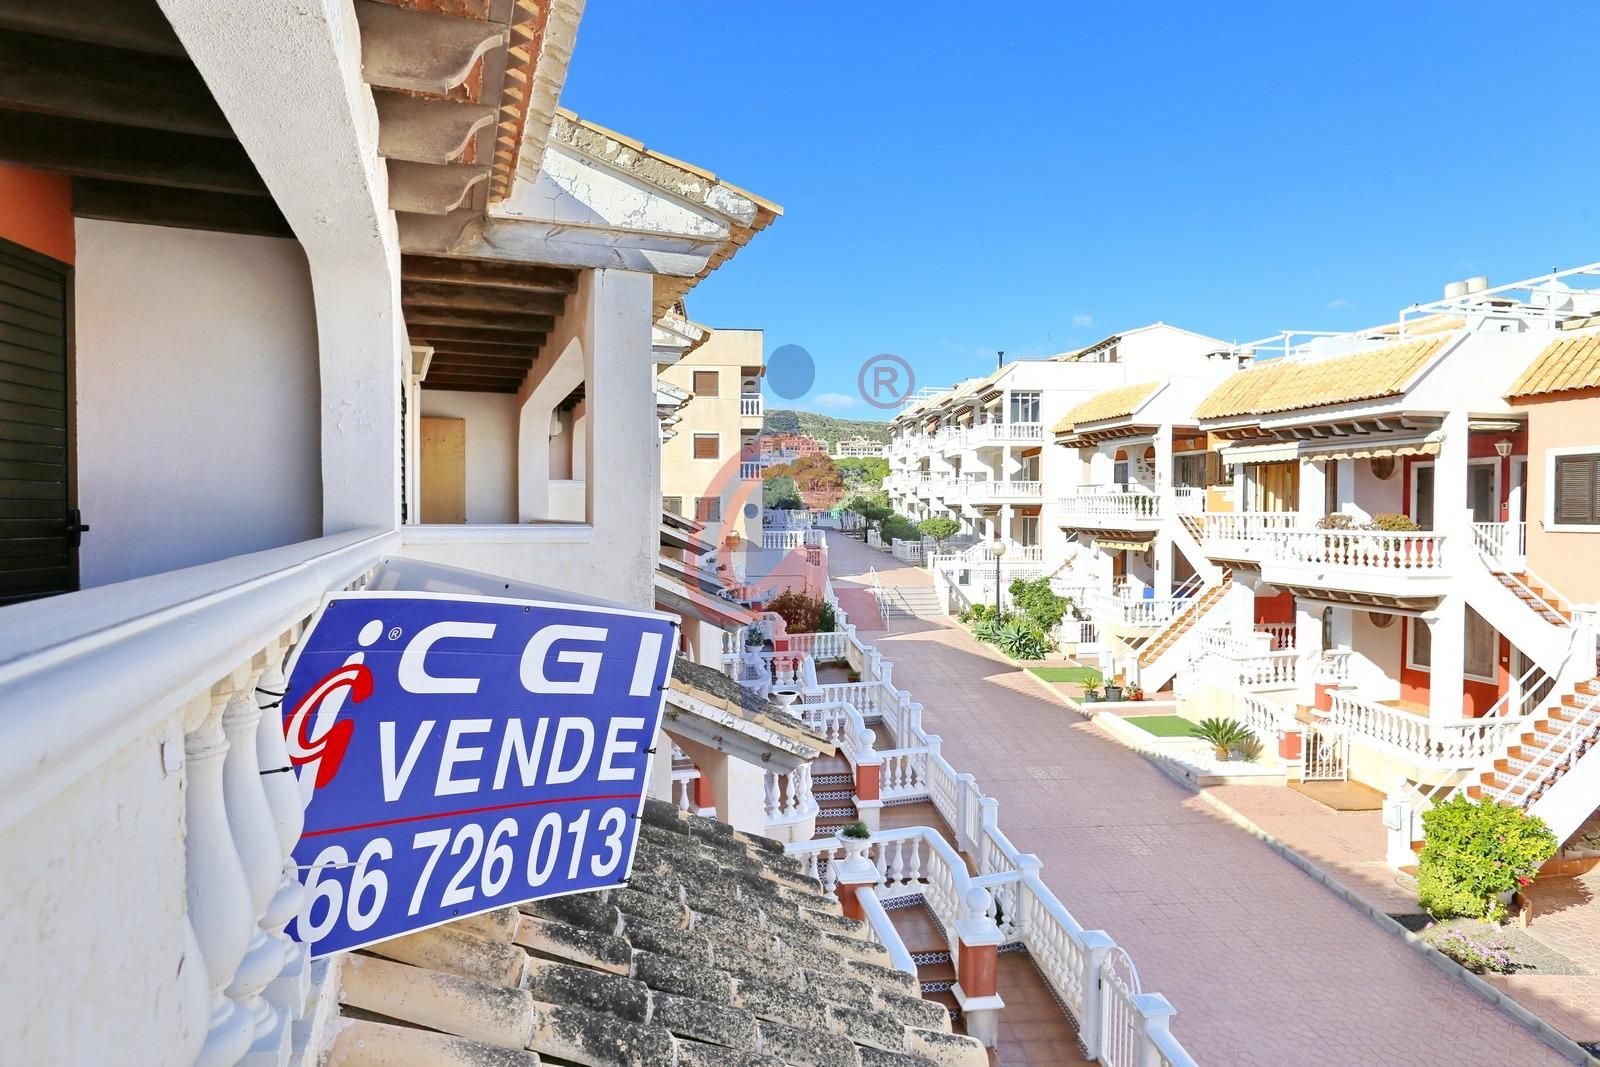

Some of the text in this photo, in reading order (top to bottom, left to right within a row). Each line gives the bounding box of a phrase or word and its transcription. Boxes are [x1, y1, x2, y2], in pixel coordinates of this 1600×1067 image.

[398, 621, 664, 697] CGI
[379, 717, 645, 803] VENDE
[291, 806, 627, 944] 66 726 013
